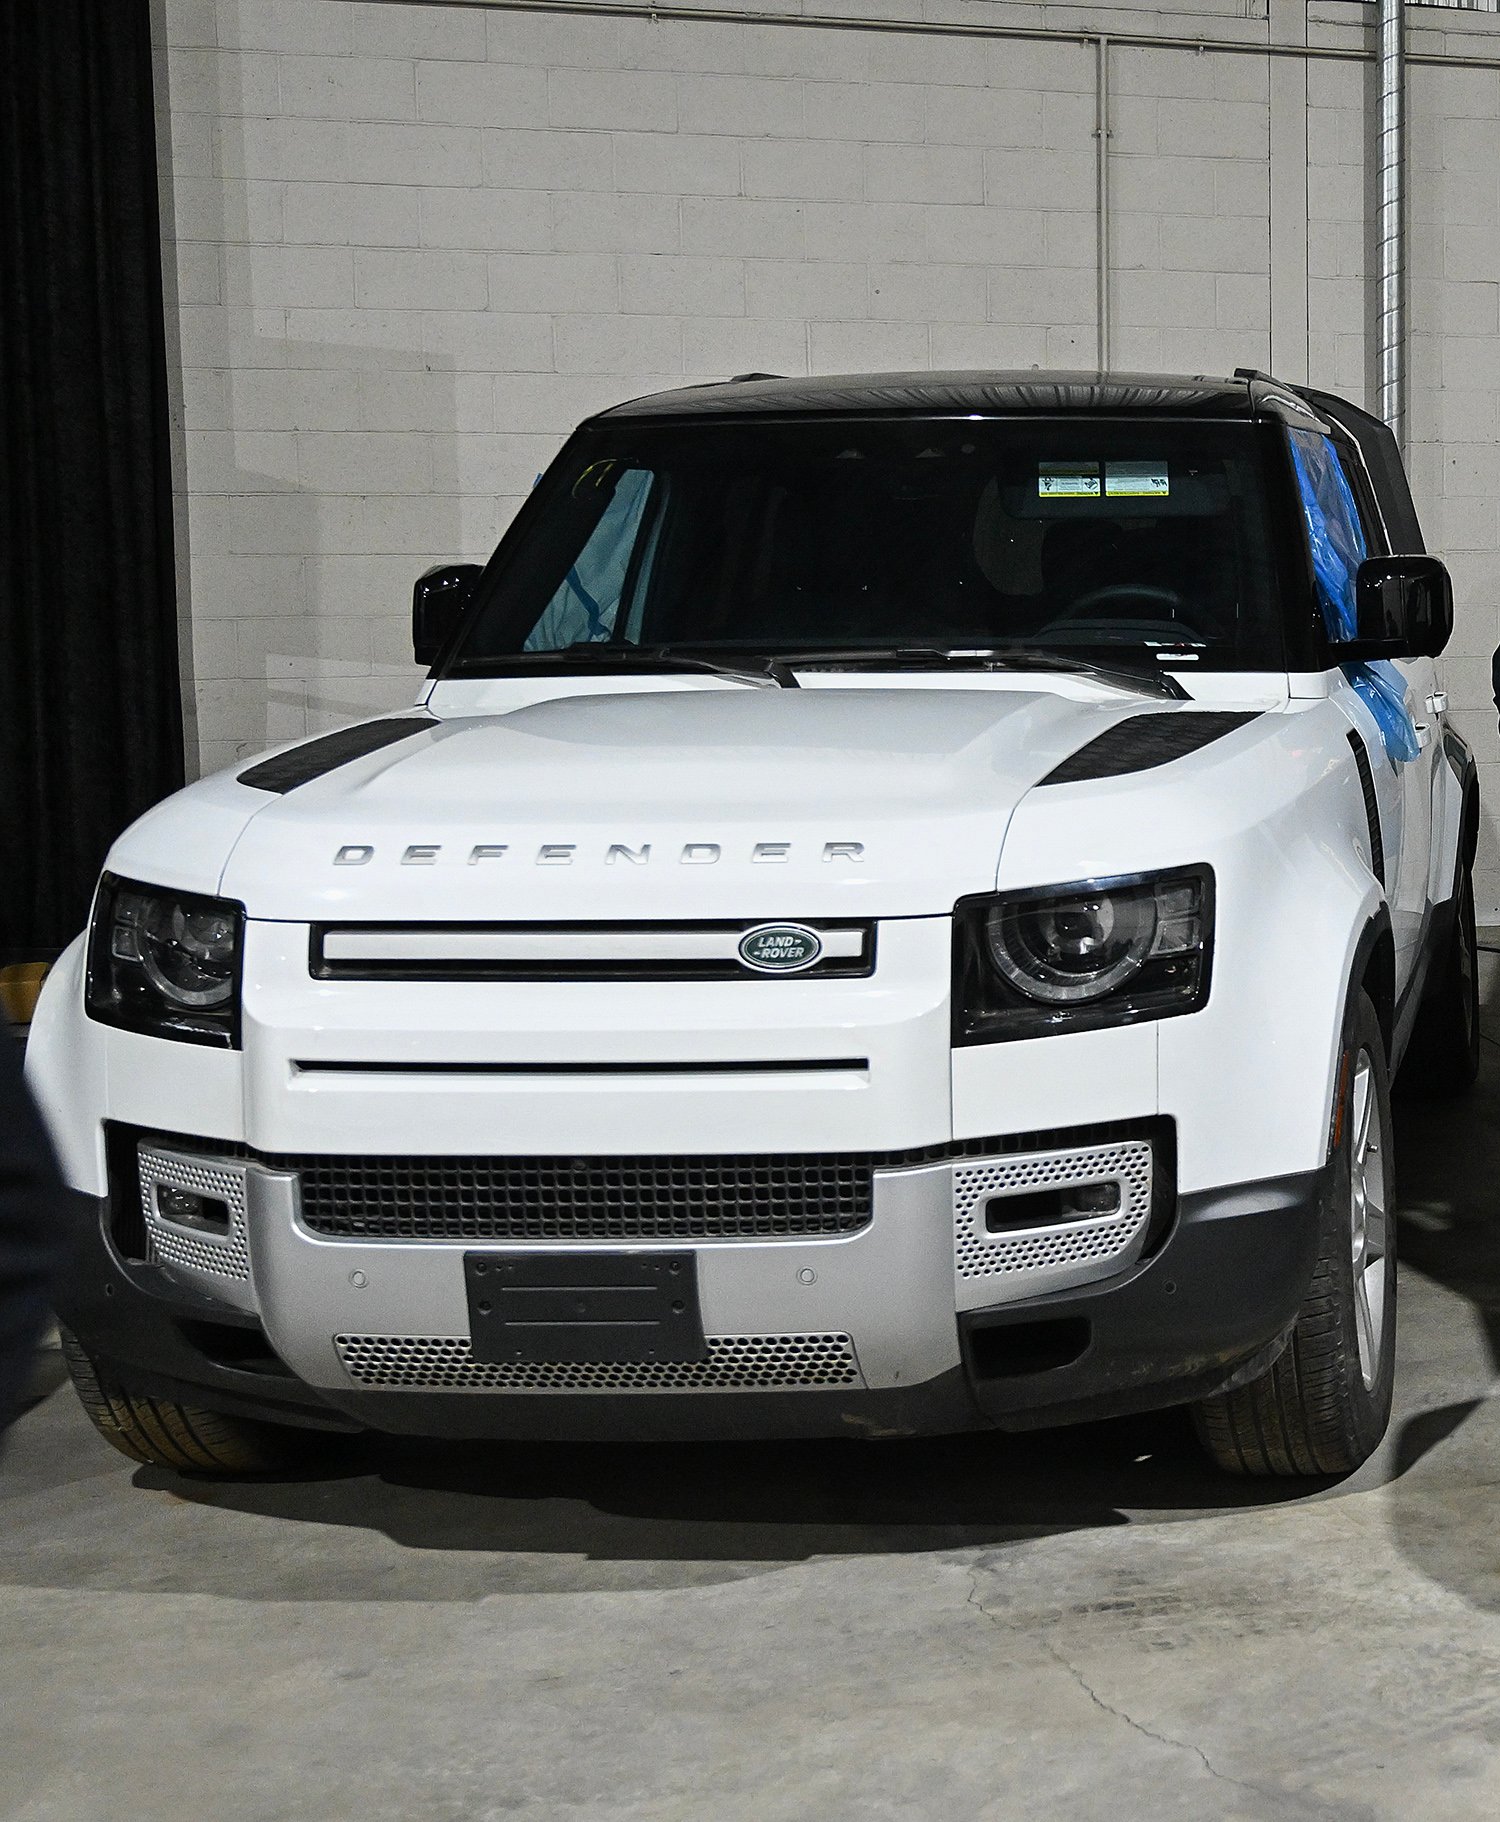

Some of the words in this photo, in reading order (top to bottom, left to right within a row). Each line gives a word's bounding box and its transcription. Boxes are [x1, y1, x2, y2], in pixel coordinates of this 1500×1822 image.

[332, 842, 866, 866] DEFENDER
[758, 936, 794, 948] LAND
[761, 947, 804, 958] ROVER
